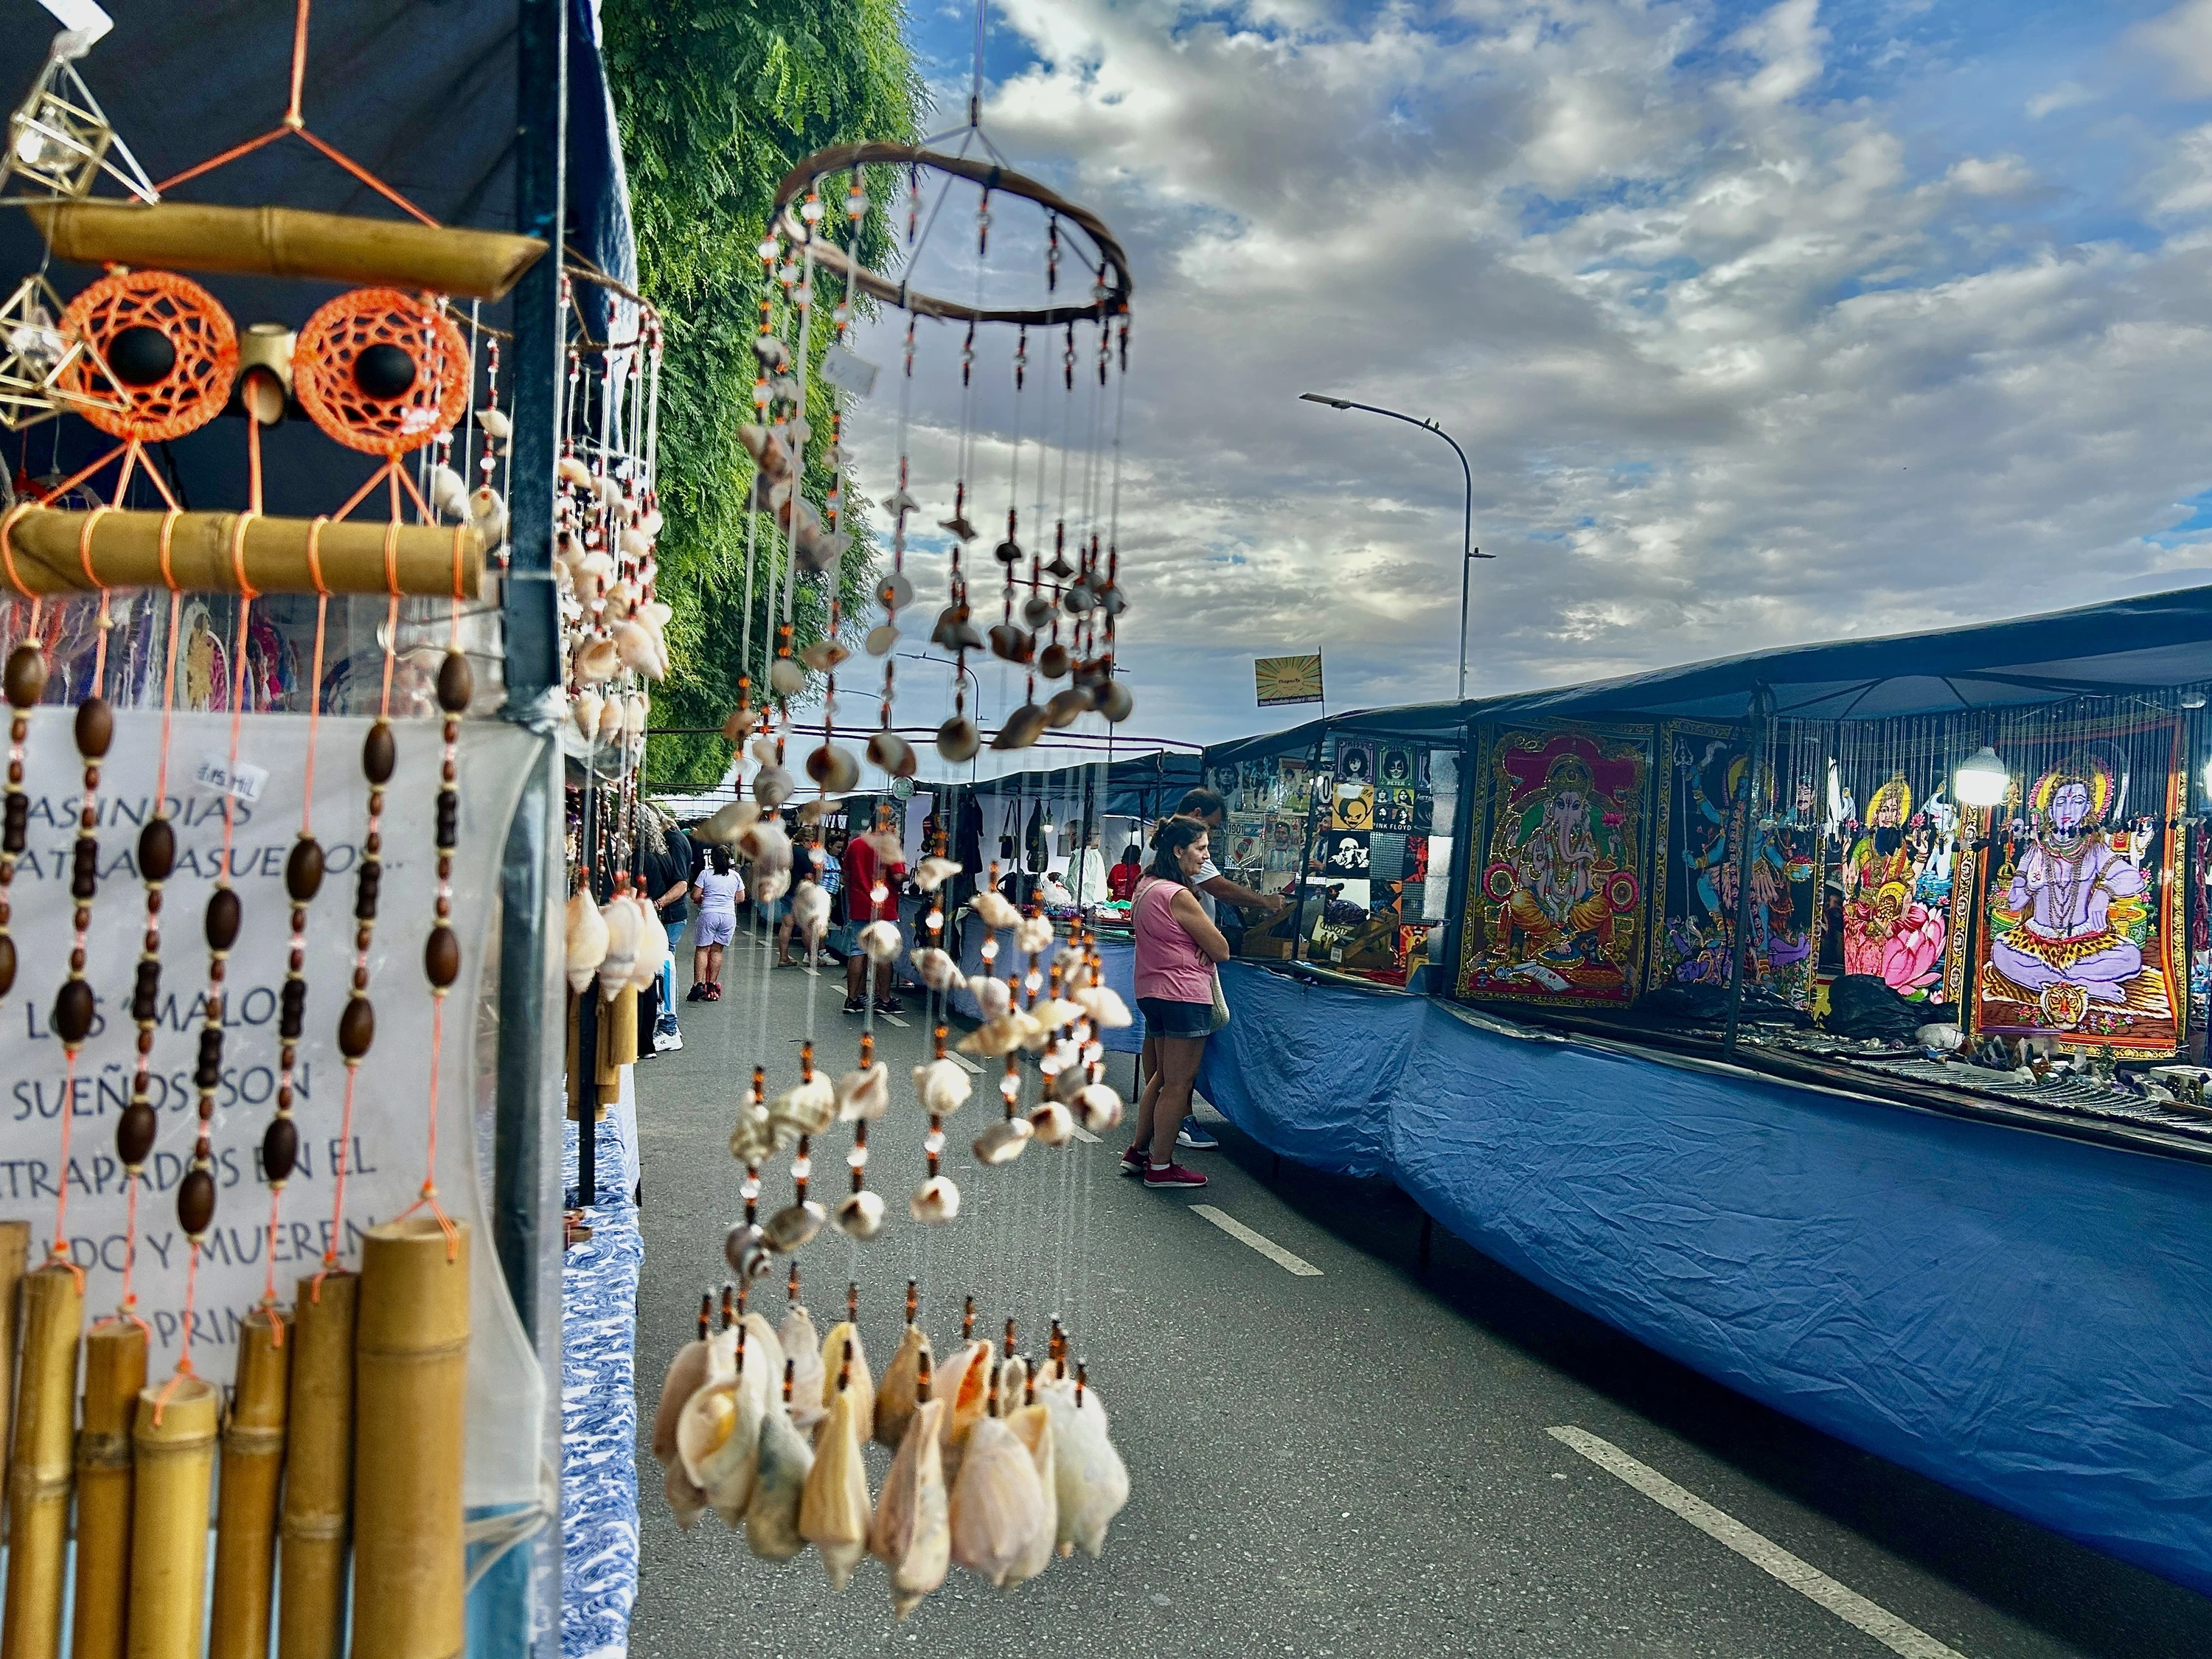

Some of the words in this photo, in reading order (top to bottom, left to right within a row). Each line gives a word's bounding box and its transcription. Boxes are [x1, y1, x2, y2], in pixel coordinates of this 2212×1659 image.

[1414, 793, 1433, 801] META
[1228, 824, 1245, 835] 1901
[329, 1135, 377, 1177] EL
[145, 1232, 173, 1269] Y
